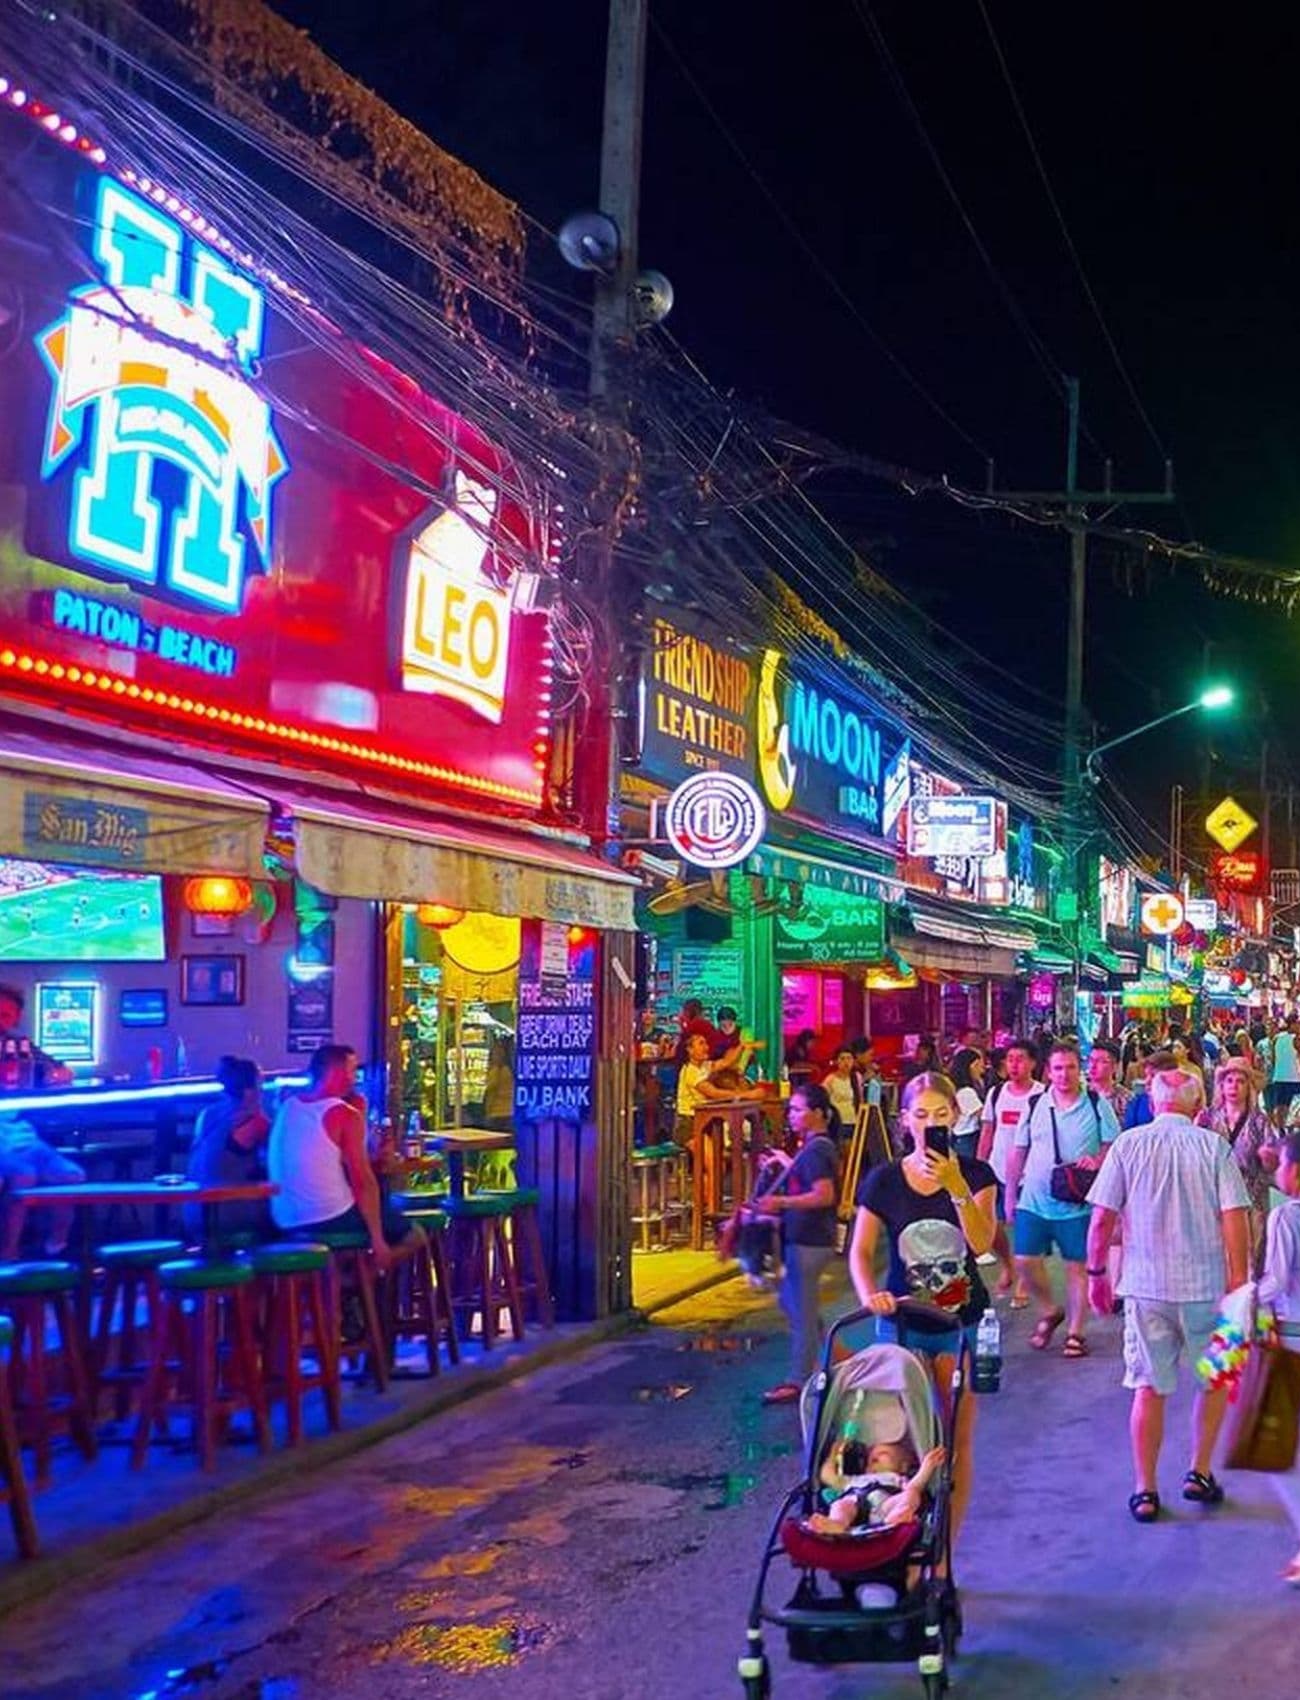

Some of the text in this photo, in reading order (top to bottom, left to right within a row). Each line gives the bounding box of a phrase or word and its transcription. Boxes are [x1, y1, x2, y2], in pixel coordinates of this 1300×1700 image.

[413, 570, 500, 681] LEO
[158, 625, 237, 677] BEACH
[653, 617, 750, 717] FRIENDSHIP
[656, 692, 747, 762] LEATHER
[793, 680, 881, 787] MOON
[40, 802, 88, 843] San
[843, 786, 879, 825] BAR
[831, 908, 879, 927] BAR
[521, 1033, 590, 1049] EACH DAY
[515, 1085, 591, 1107] DJ BANK
